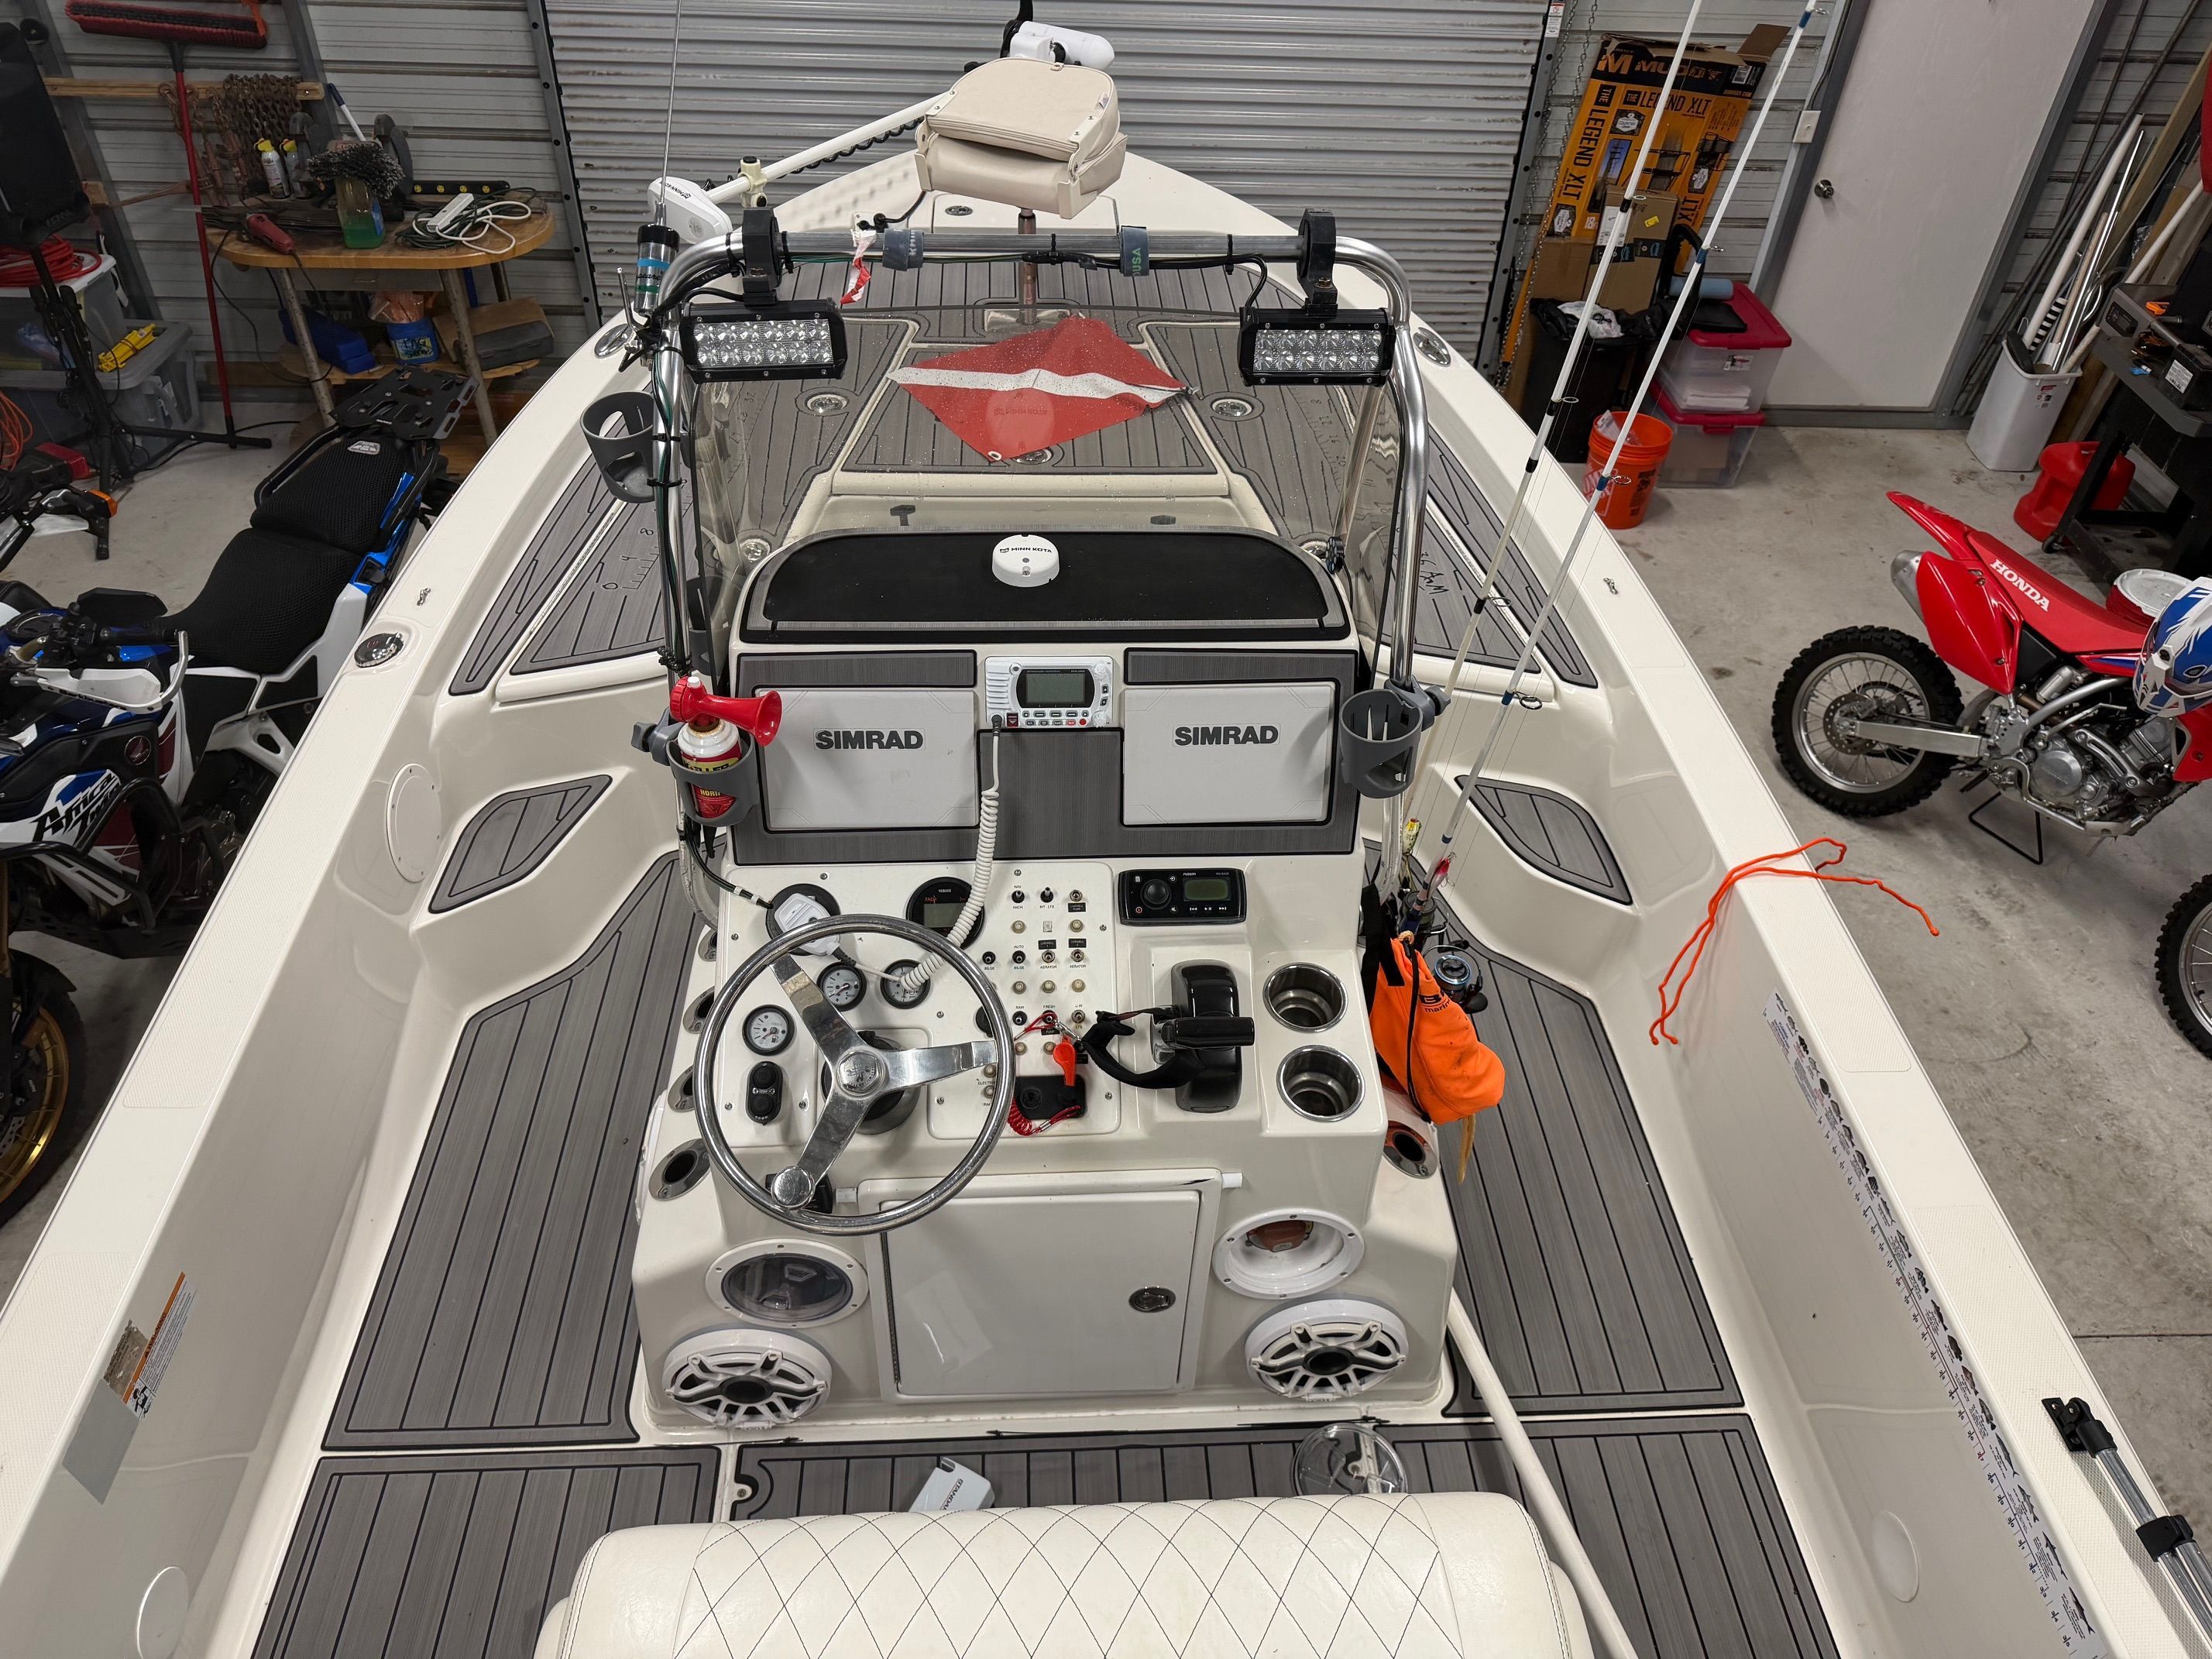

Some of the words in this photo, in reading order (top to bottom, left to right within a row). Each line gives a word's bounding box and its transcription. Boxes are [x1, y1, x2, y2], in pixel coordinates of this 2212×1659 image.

[1599, 88, 1613, 103] THE
[1640, 91, 1686, 112] LEGND
[1687, 98, 1712, 115] XLT
[1573, 108, 1609, 168] LEGEND
[1562, 171, 1587, 201] XLT
[1989, 558, 2050, 612] HONDA
[816, 730, 924, 750] SIMRAD
[1174, 725, 1279, 747] SIMRAD
[1425, 999, 1451, 1013] marin
[148, 1313, 167, 1350] WARNING
